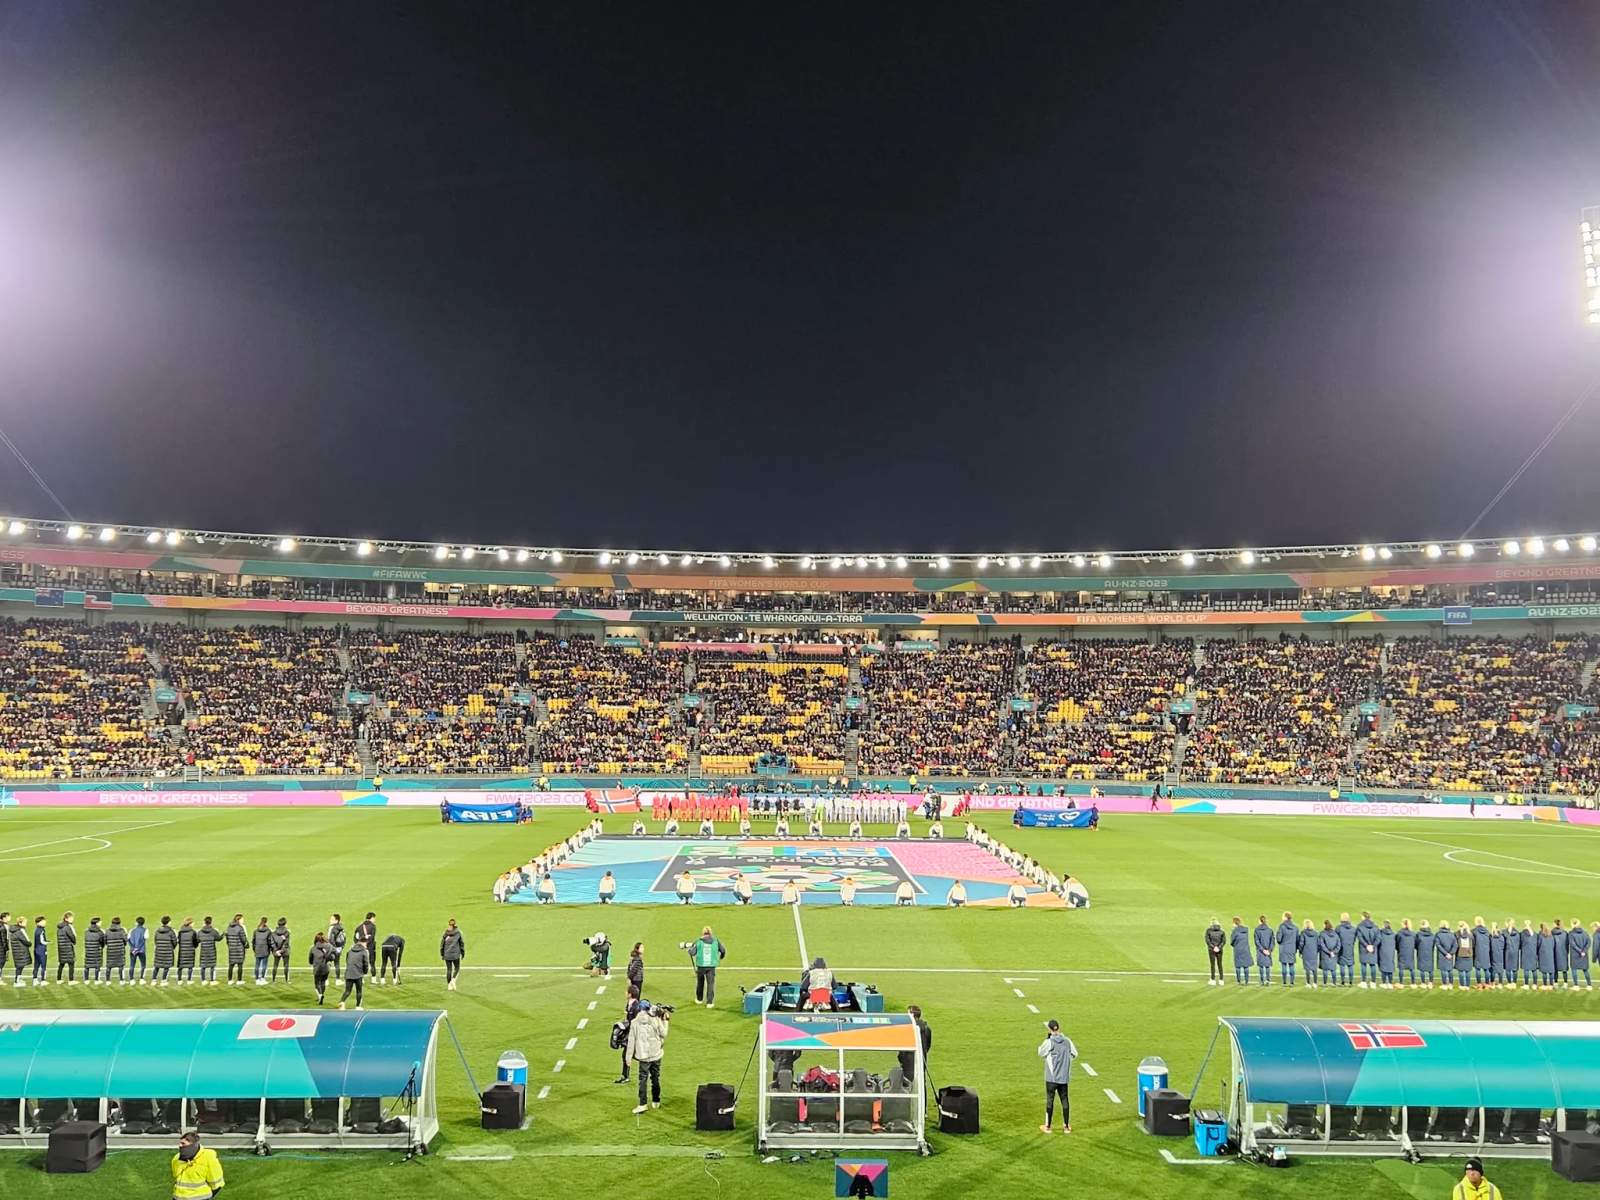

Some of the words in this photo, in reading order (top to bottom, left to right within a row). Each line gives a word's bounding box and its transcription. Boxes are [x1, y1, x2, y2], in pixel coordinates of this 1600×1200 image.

[372, 569, 428, 579] #FIFAWWC
[1496, 568, 1543, 577] BEYOND
[708, 579, 728, 589] FIFA
[774, 580, 809, 589] WORLD
[810, 580, 829, 589] CUP
[345, 604, 387, 613] BEYOND
[389, 606, 449, 616] GREATNESS
[1447, 611, 1468, 619] FIFA
[683, 613, 743, 621] WELLINGTON
[748, 614, 761, 622] TE
[762, 614, 863, 623] WHANGANUI-A-TARA
[1076, 615, 1097, 623] FIFA
[1098, 615, 1145, 623] WOMEN'S
[1146, 615, 1182, 623] WORLD
[1185, 614, 1207, 622] CUP
[100, 793, 158, 803] BEYOND
[161, 793, 248, 803] GREATNESS
[1312, 803, 1420, 815] FWWC2023.COM
